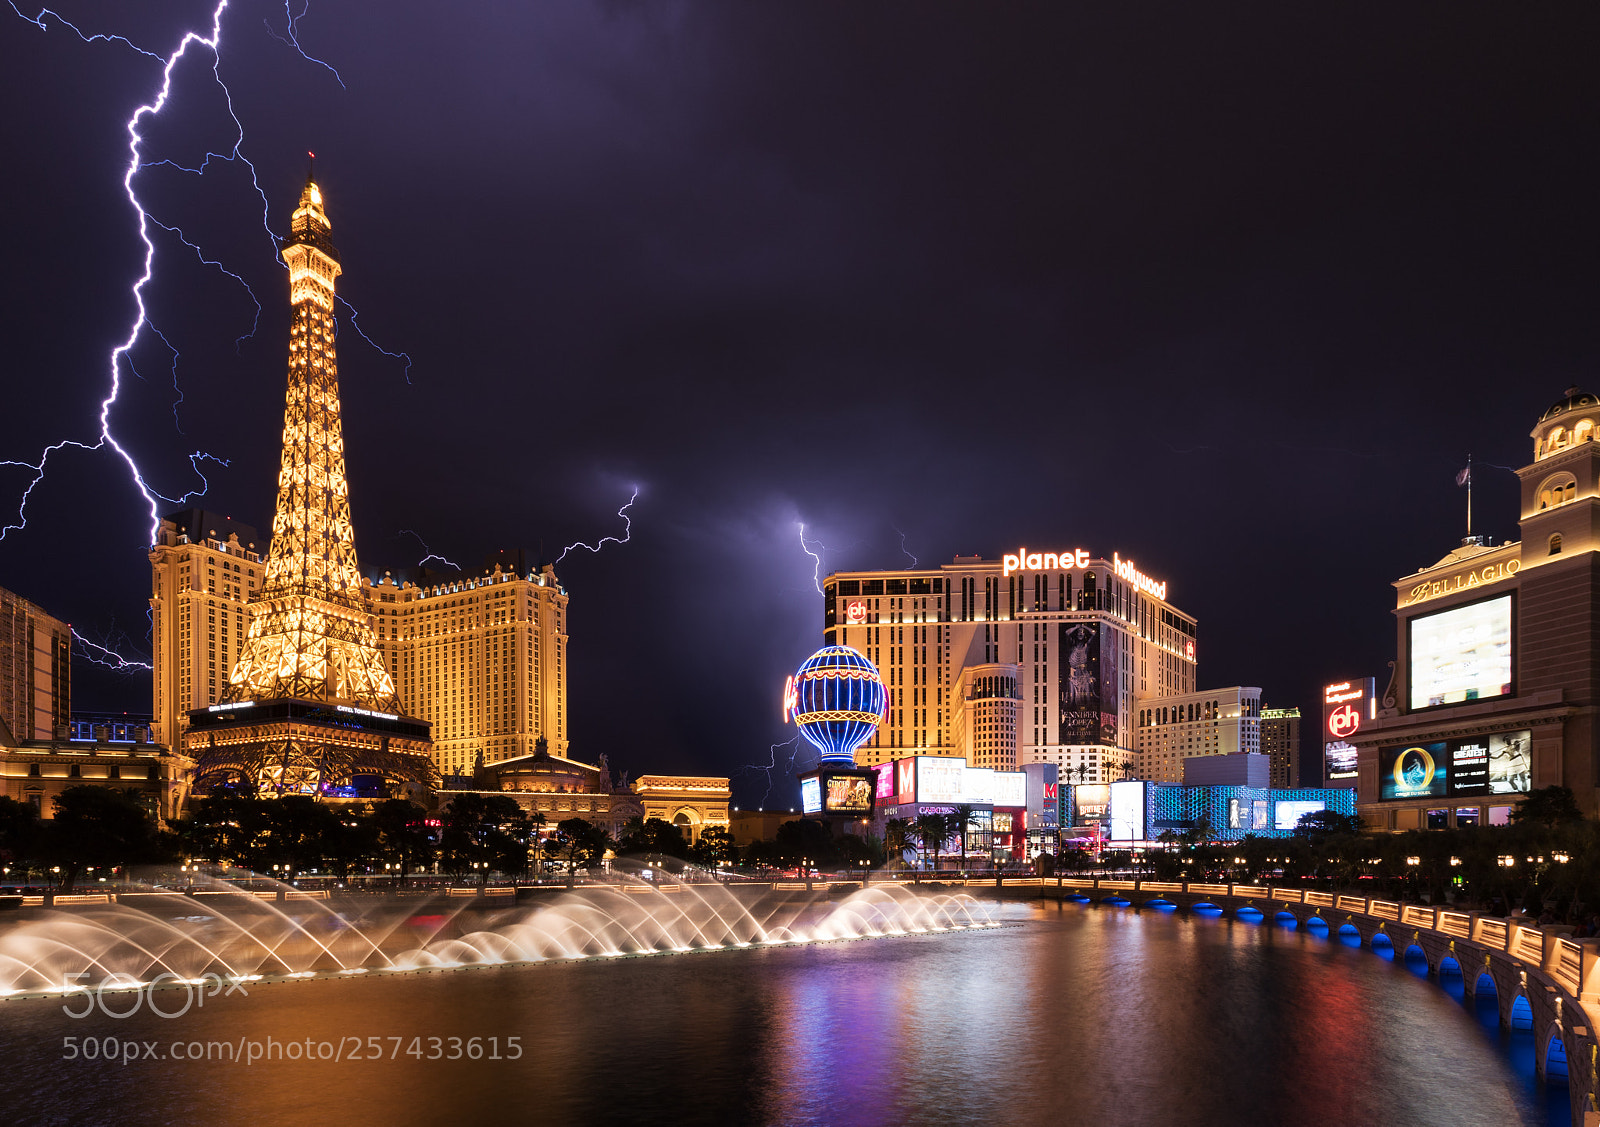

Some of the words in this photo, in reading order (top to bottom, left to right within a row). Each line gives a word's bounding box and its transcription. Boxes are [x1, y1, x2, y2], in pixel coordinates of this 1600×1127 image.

[1003, 547, 1090, 577] planet
[1114, 551, 1167, 601] hollywood
[1405, 558, 1522, 605] BELLAGIO
[849, 601, 867, 618] ph
[1060, 709, 1099, 721] JENNIFER
[1332, 704, 1360, 734] ph
[1453, 748, 1487, 759] GREATEST
[899, 762, 914, 795] M
[1043, 783, 1058, 799] M
[1079, 804, 1107, 816] BRITNEY
